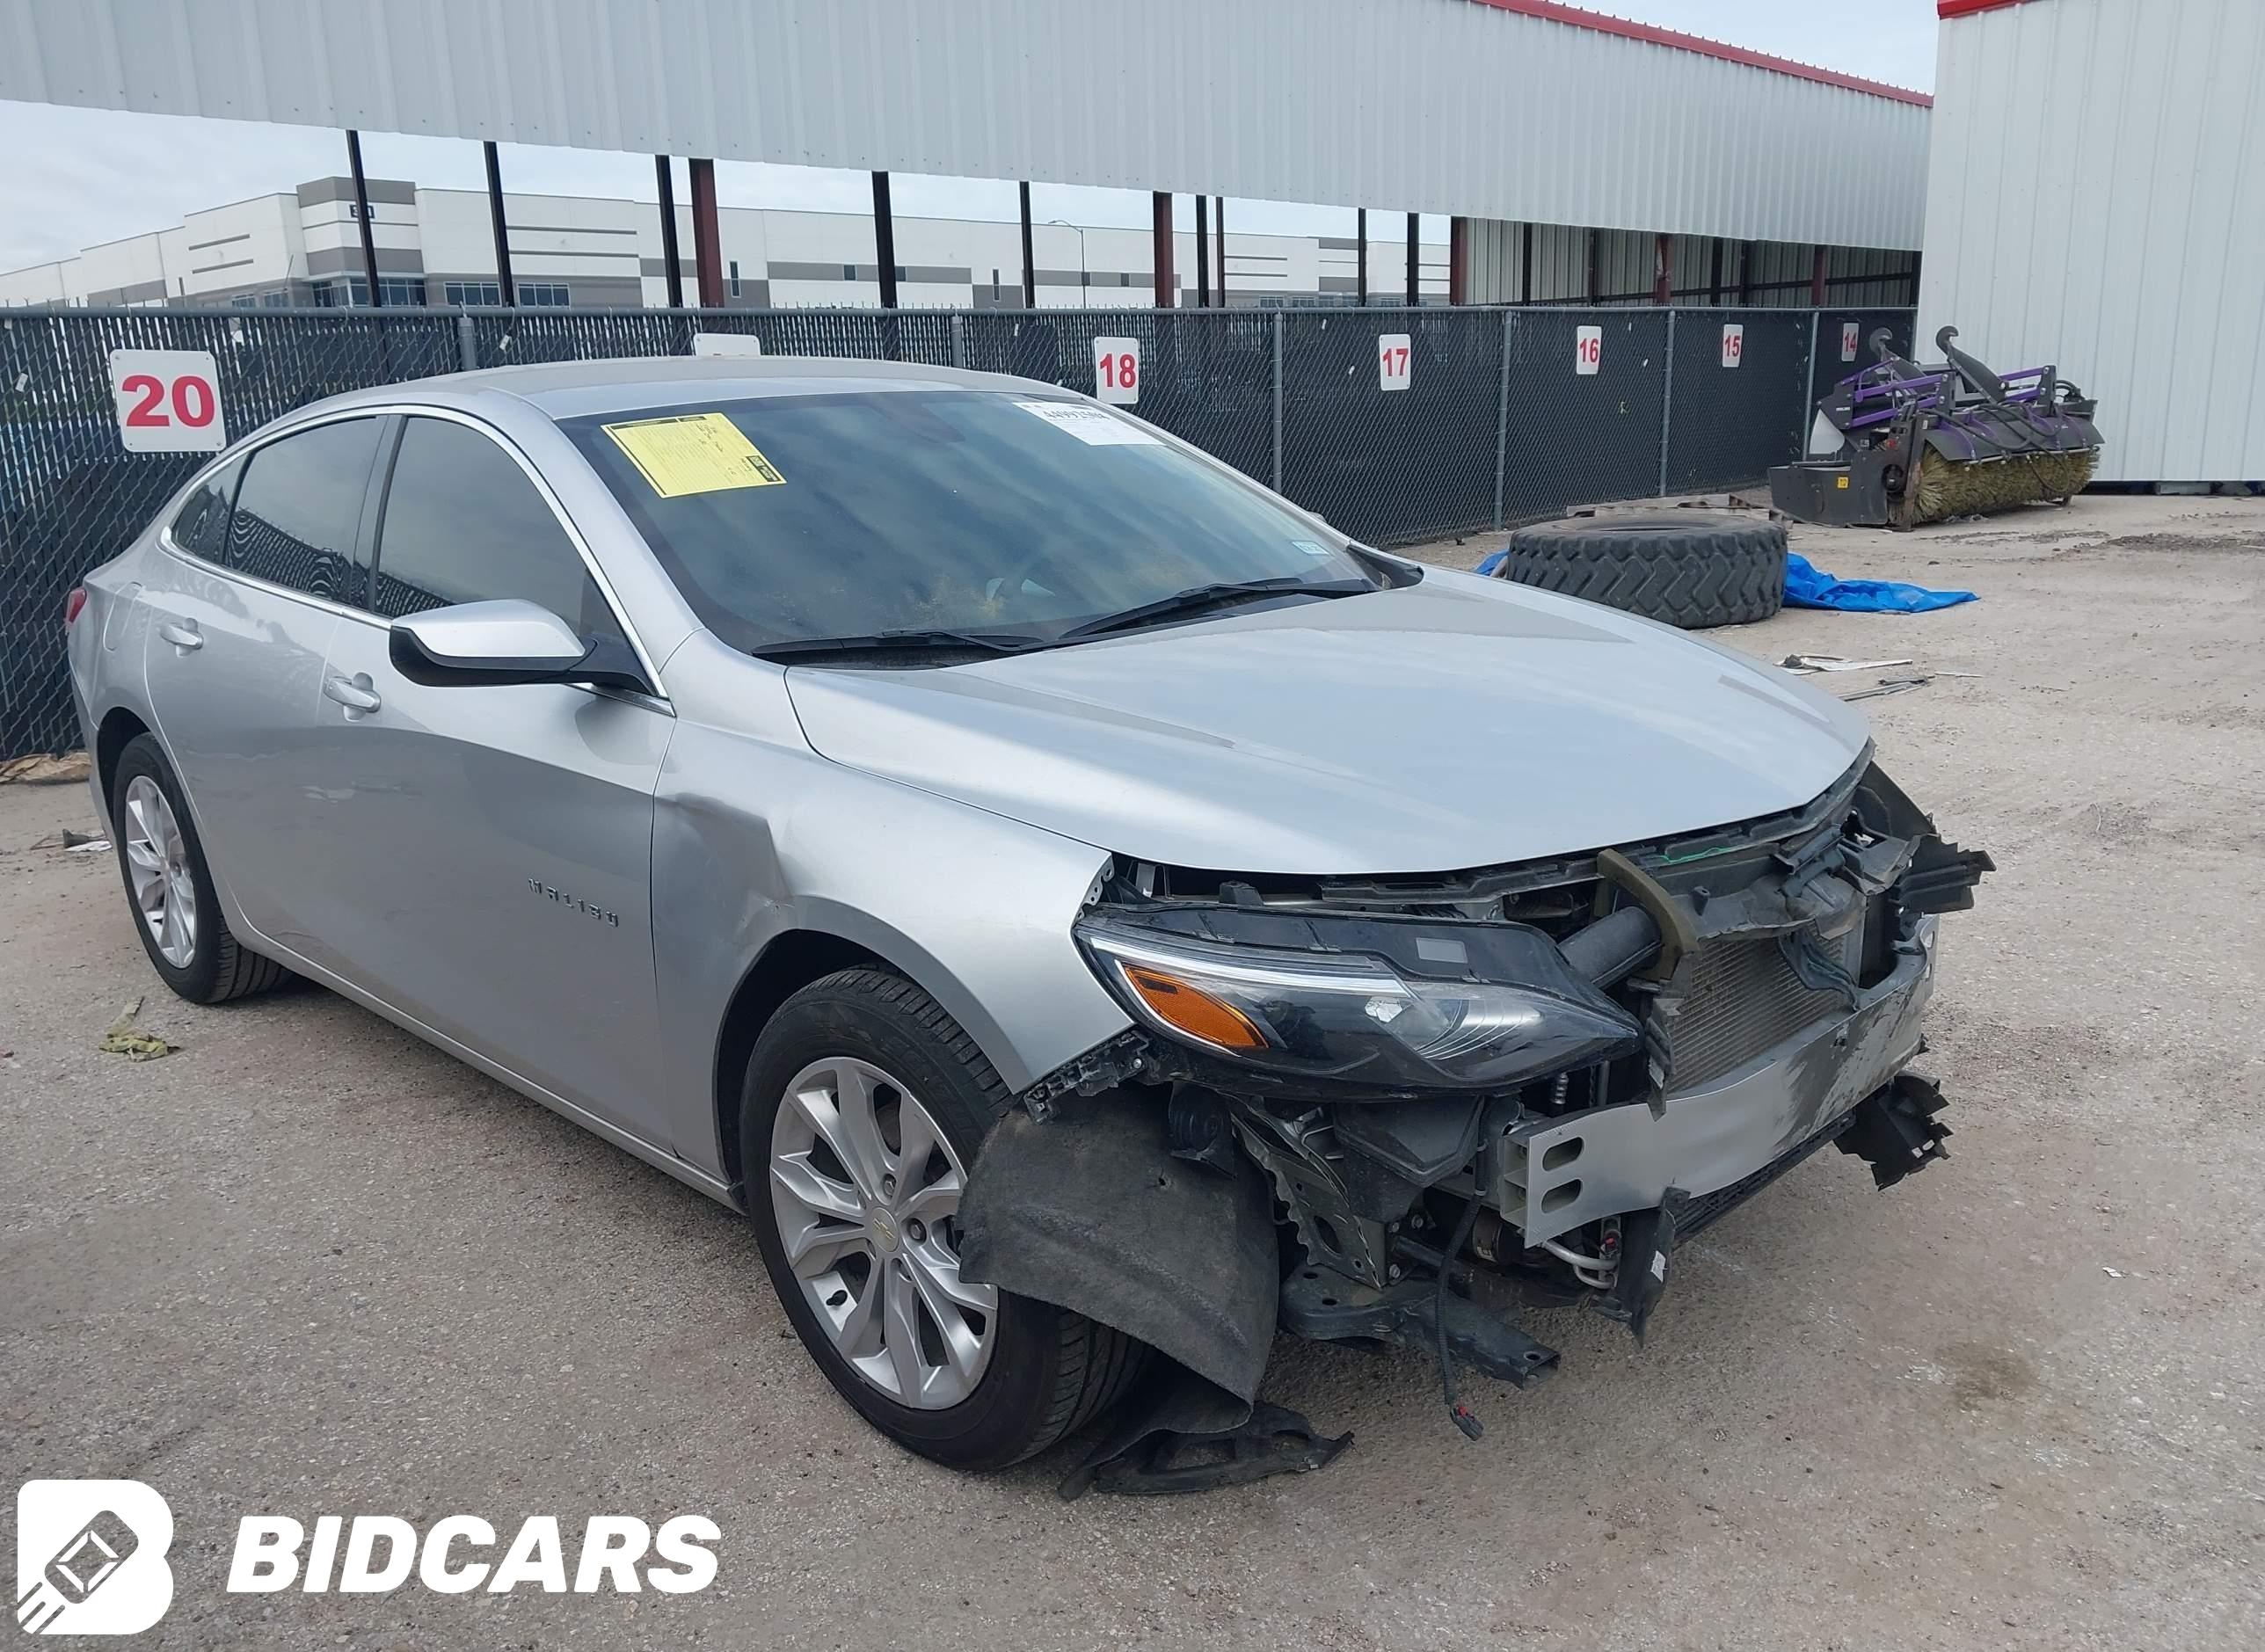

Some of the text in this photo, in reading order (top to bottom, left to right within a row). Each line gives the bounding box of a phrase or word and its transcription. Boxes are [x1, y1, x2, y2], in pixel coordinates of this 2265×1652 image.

[1579, 338, 1599, 363] 16
[1724, 334, 1741, 357] 15
[1844, 331, 1857, 353] 14
[1099, 353, 1137, 389] 18
[1382, 348, 1409, 377] 17
[121, 375, 215, 427] 20
[528, 877, 619, 928] MALIBU
